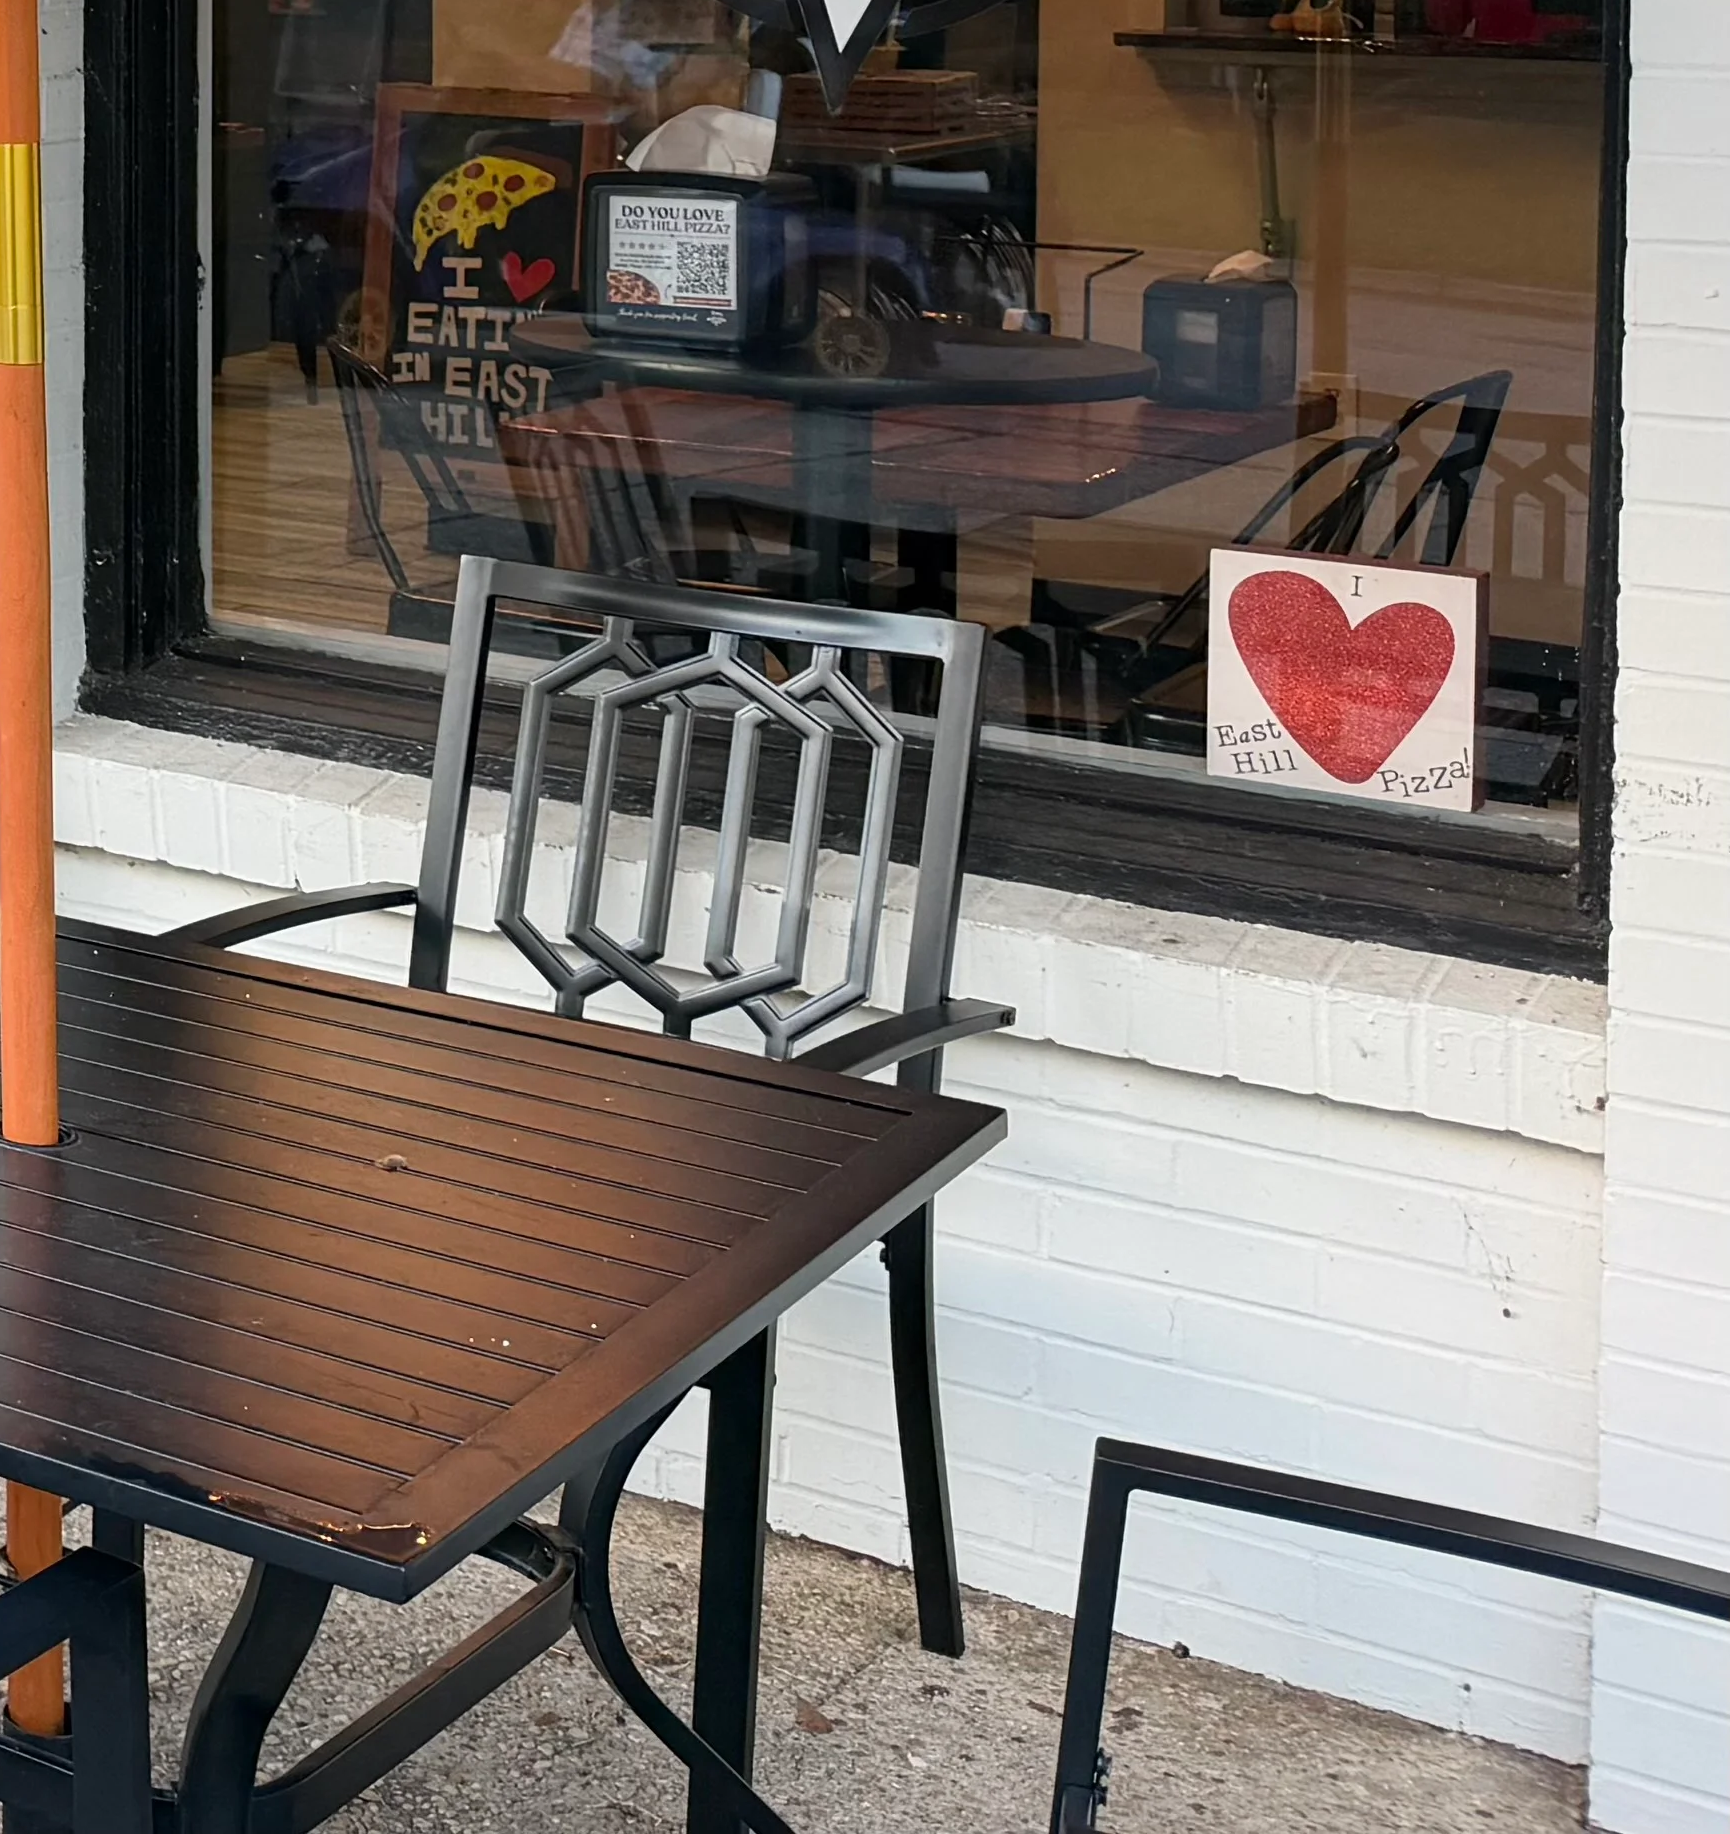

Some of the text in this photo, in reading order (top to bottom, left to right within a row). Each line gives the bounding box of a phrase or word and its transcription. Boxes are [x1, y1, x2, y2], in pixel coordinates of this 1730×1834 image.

[622, 205, 725, 221] DO YOU LOVE
[615, 219, 731, 234] EAST HILL PIZZA?
[442, 257, 482, 299] I
[392, 352, 554, 412] IN EAST
[420, 401, 510, 448] HIL
[1351, 575, 1363, 597] I
[1230, 750, 1298, 775] Hill
